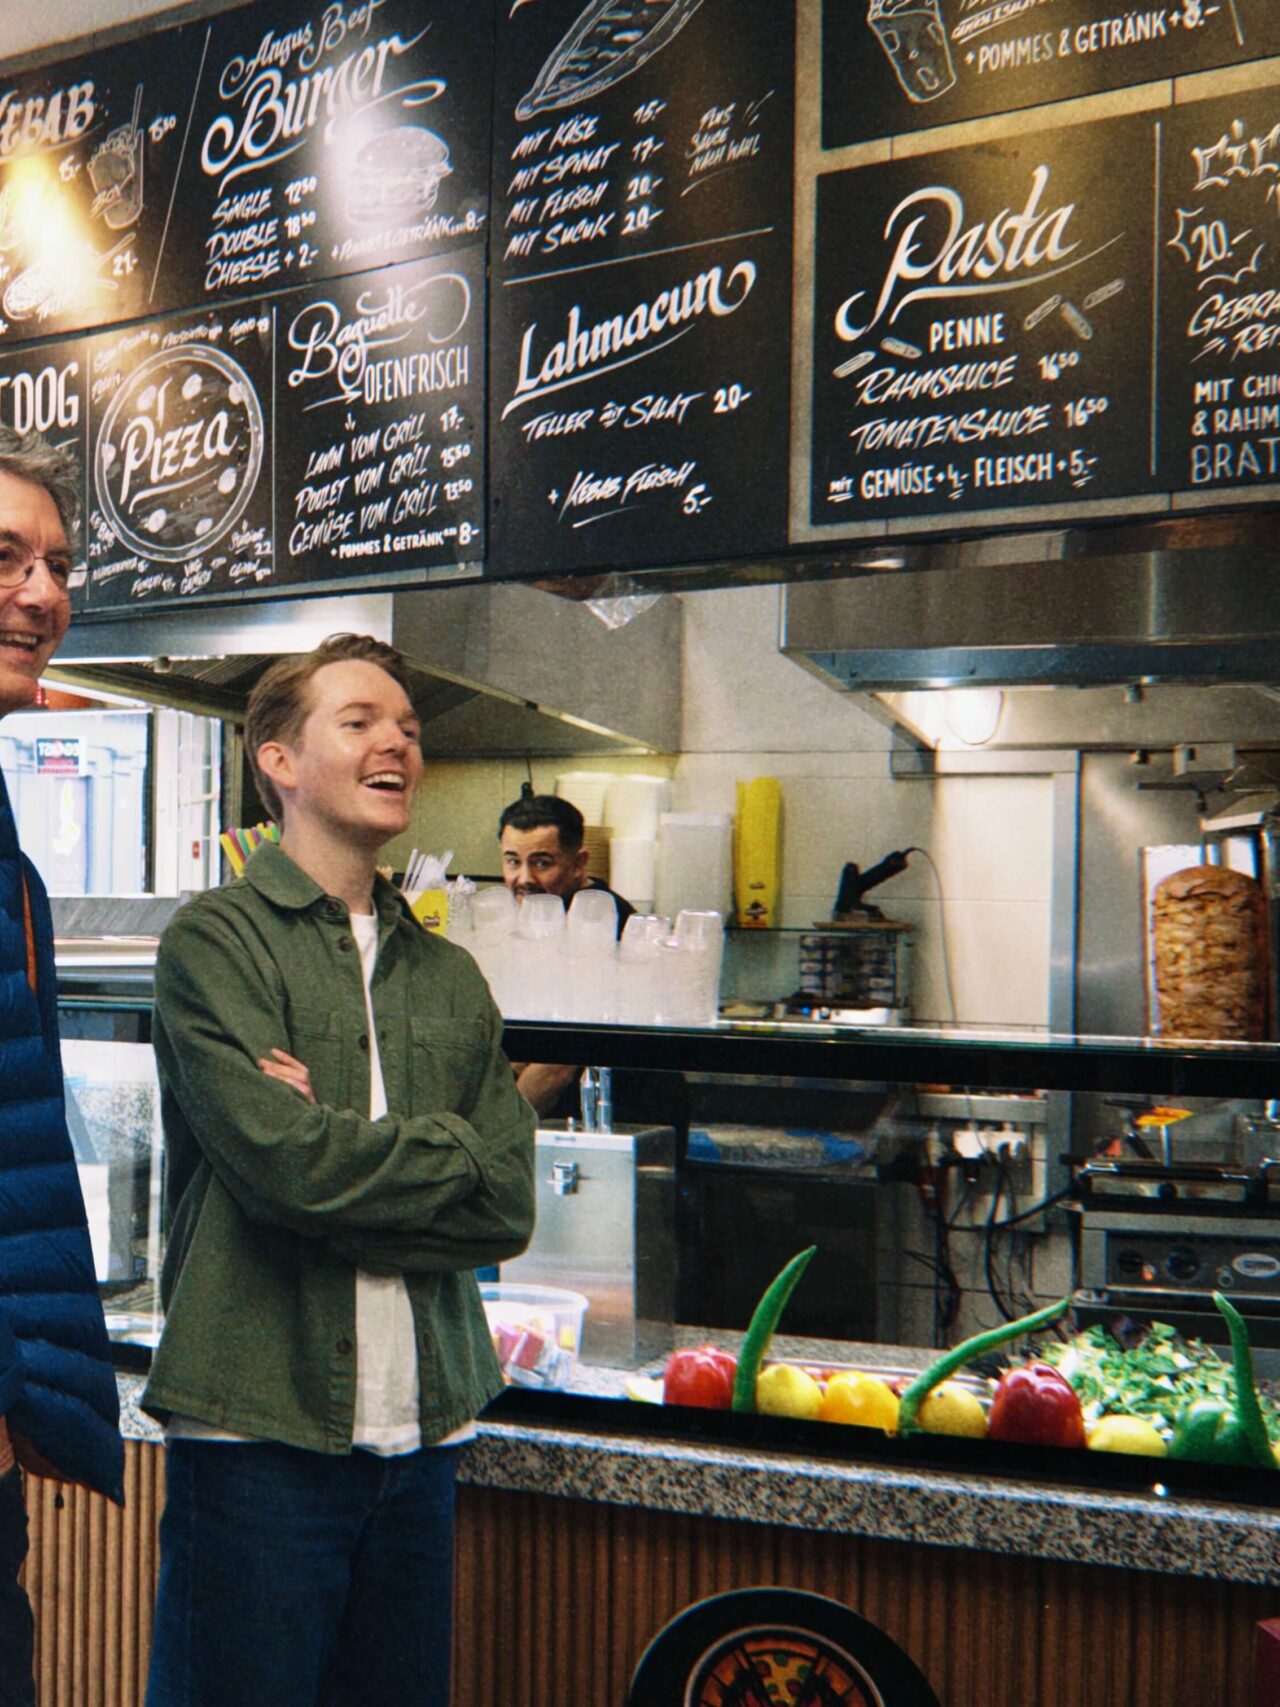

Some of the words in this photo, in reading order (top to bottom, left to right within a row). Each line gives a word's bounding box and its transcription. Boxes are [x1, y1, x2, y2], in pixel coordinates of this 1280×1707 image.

[220, 24, 312, 99] Angus
[299, 0, 387, 71] Beef
[977, 32, 1053, 74] POMMES
[1058, 28, 1071, 58] &
[1075, 9, 1167, 53] GETRÄNK
[201, 22, 432, 176] Burger
[549, 114, 600, 151] KÄSE
[206, 218, 277, 264] DOUBLE
[542, 212, 616, 253] SUCUK
[834, 164, 1082, 342] Pasta
[205, 250, 280, 291] CHEESE
[288, 272, 470, 392] Baguette
[514, 260, 757, 396] Lahmacun
[929, 312, 1005, 352] PENNE
[363, 345, 468, 405] OFENFRISCH
[855, 354, 1018, 406] RAHMSAUCE
[1194, 377, 1234, 404] MIT
[120, 377, 238, 505] Pizza
[522, 408, 595, 443] TELLER
[624, 391, 707, 428] SALAT
[850, 403, 1052, 454] TOMATENSAUCE
[1191, 408, 1209, 437] &
[304, 443, 345, 480] LAMM
[351, 429, 381, 463] VOM
[354, 462, 385, 496] VOM
[860, 461, 936, 501] GEMÜSE
[974, 451, 1053, 489] FLEISCH
[557, 471, 623, 523] KEBAB
[289, 510, 355, 556] GEMÜSE
[360, 497, 392, 533] VOM
[339, 539, 381, 559] POMMES
[392, 529, 444, 552] GETRÄNK
